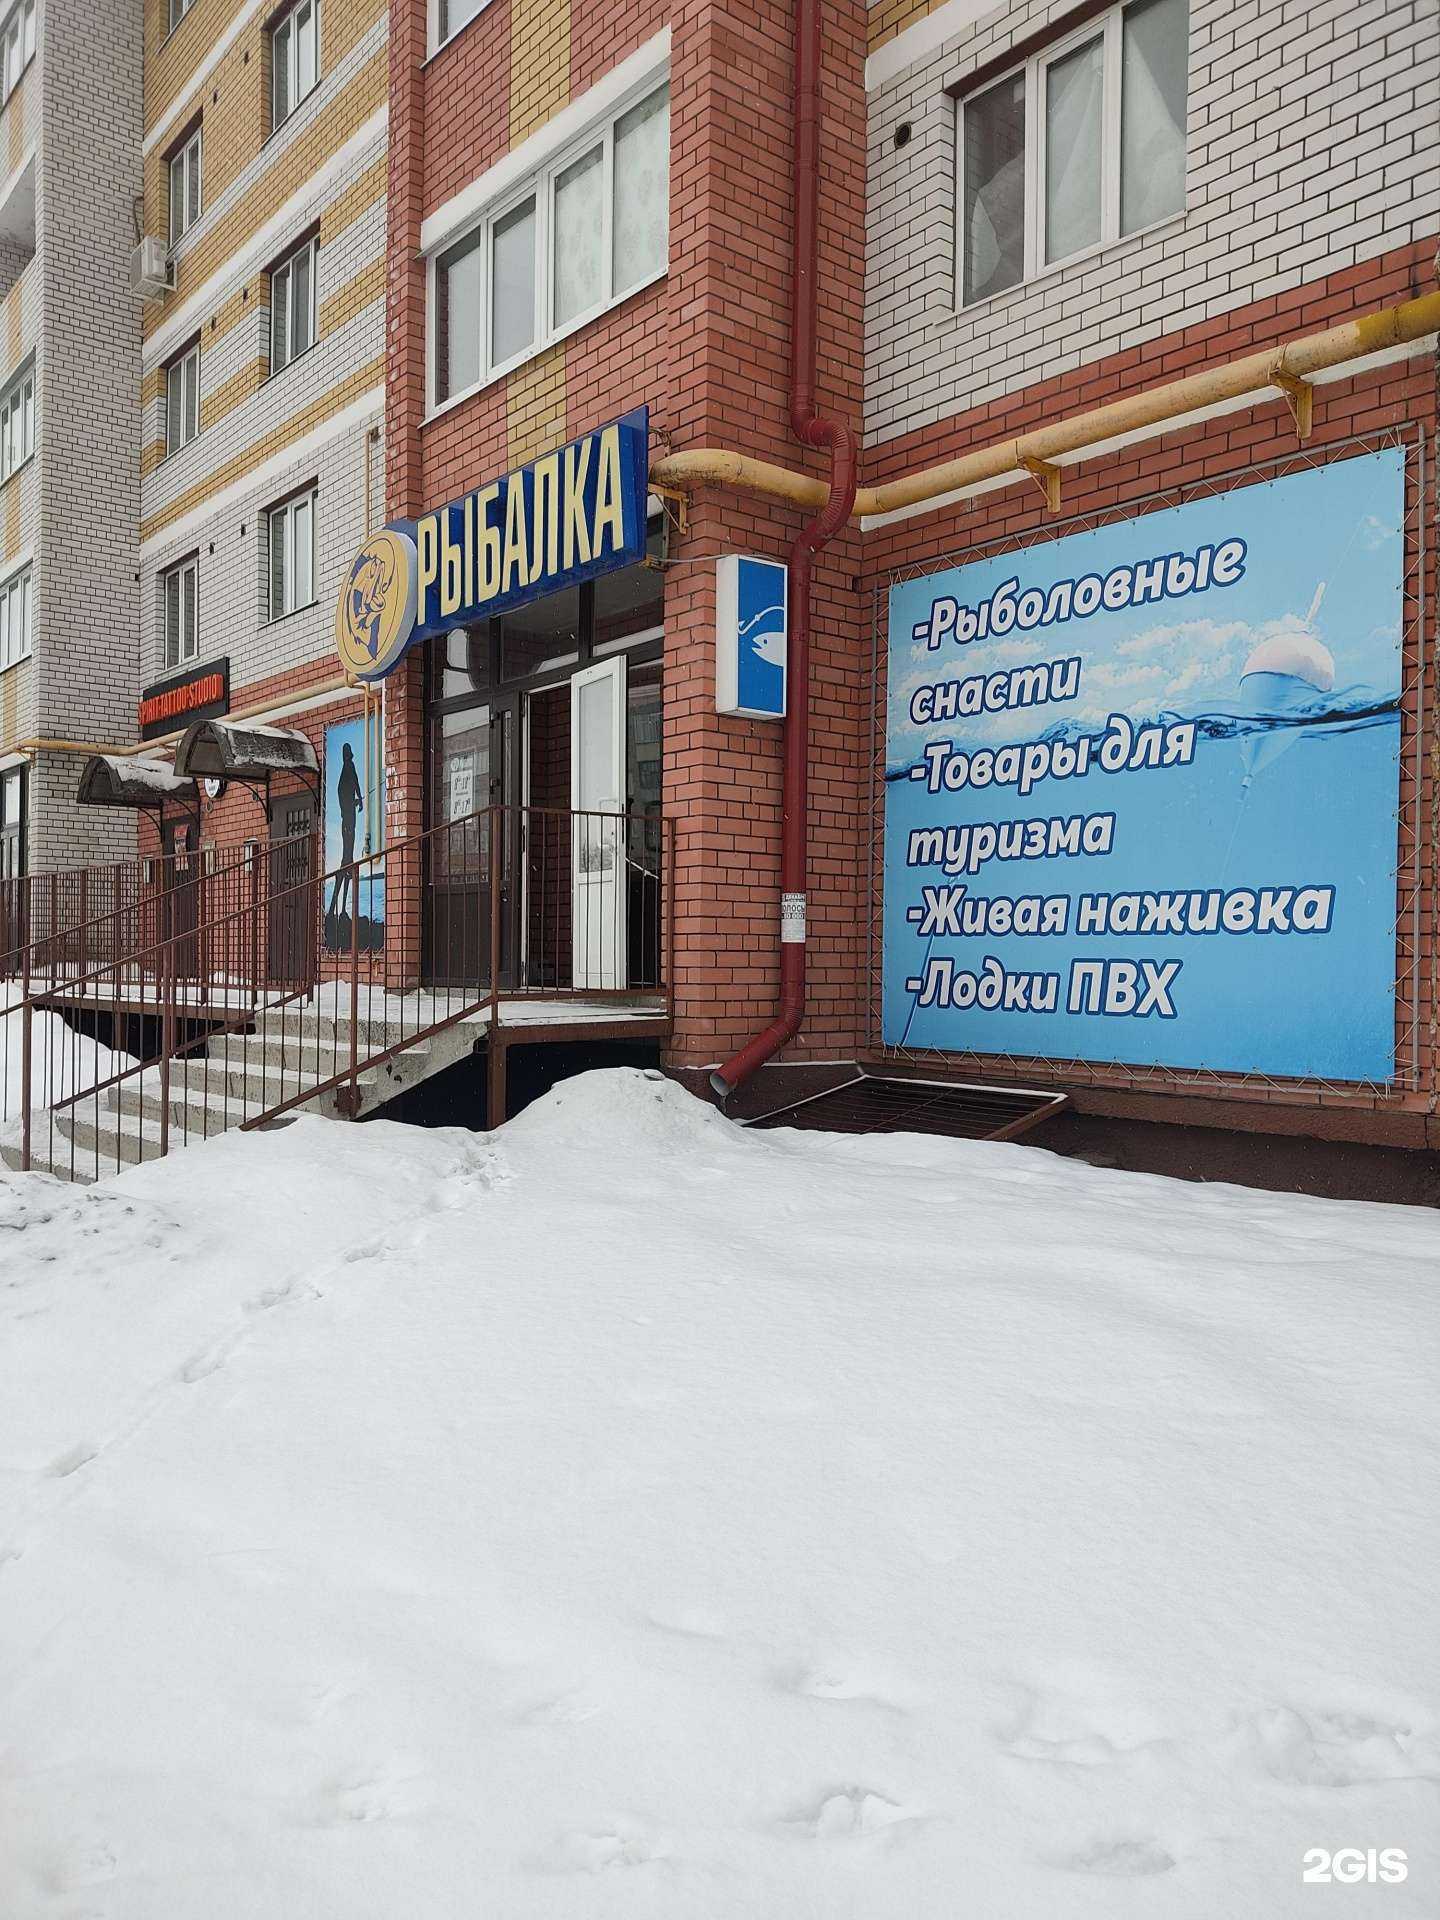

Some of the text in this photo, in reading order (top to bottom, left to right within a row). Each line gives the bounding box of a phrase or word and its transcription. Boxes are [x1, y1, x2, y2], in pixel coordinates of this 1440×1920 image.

[417, 424, 624, 626] РЫБАЛКА
[912, 539, 1246, 650] -Рыболовные
[910, 658, 1081, 724] снасти
[910, 715, 1198, 796] -Товары для
[906, 811, 1116, 875] туризма
[907, 884, 1335, 936] -Живая наживка
[905, 956, 1183, 1018] -Лодки ПВХ
